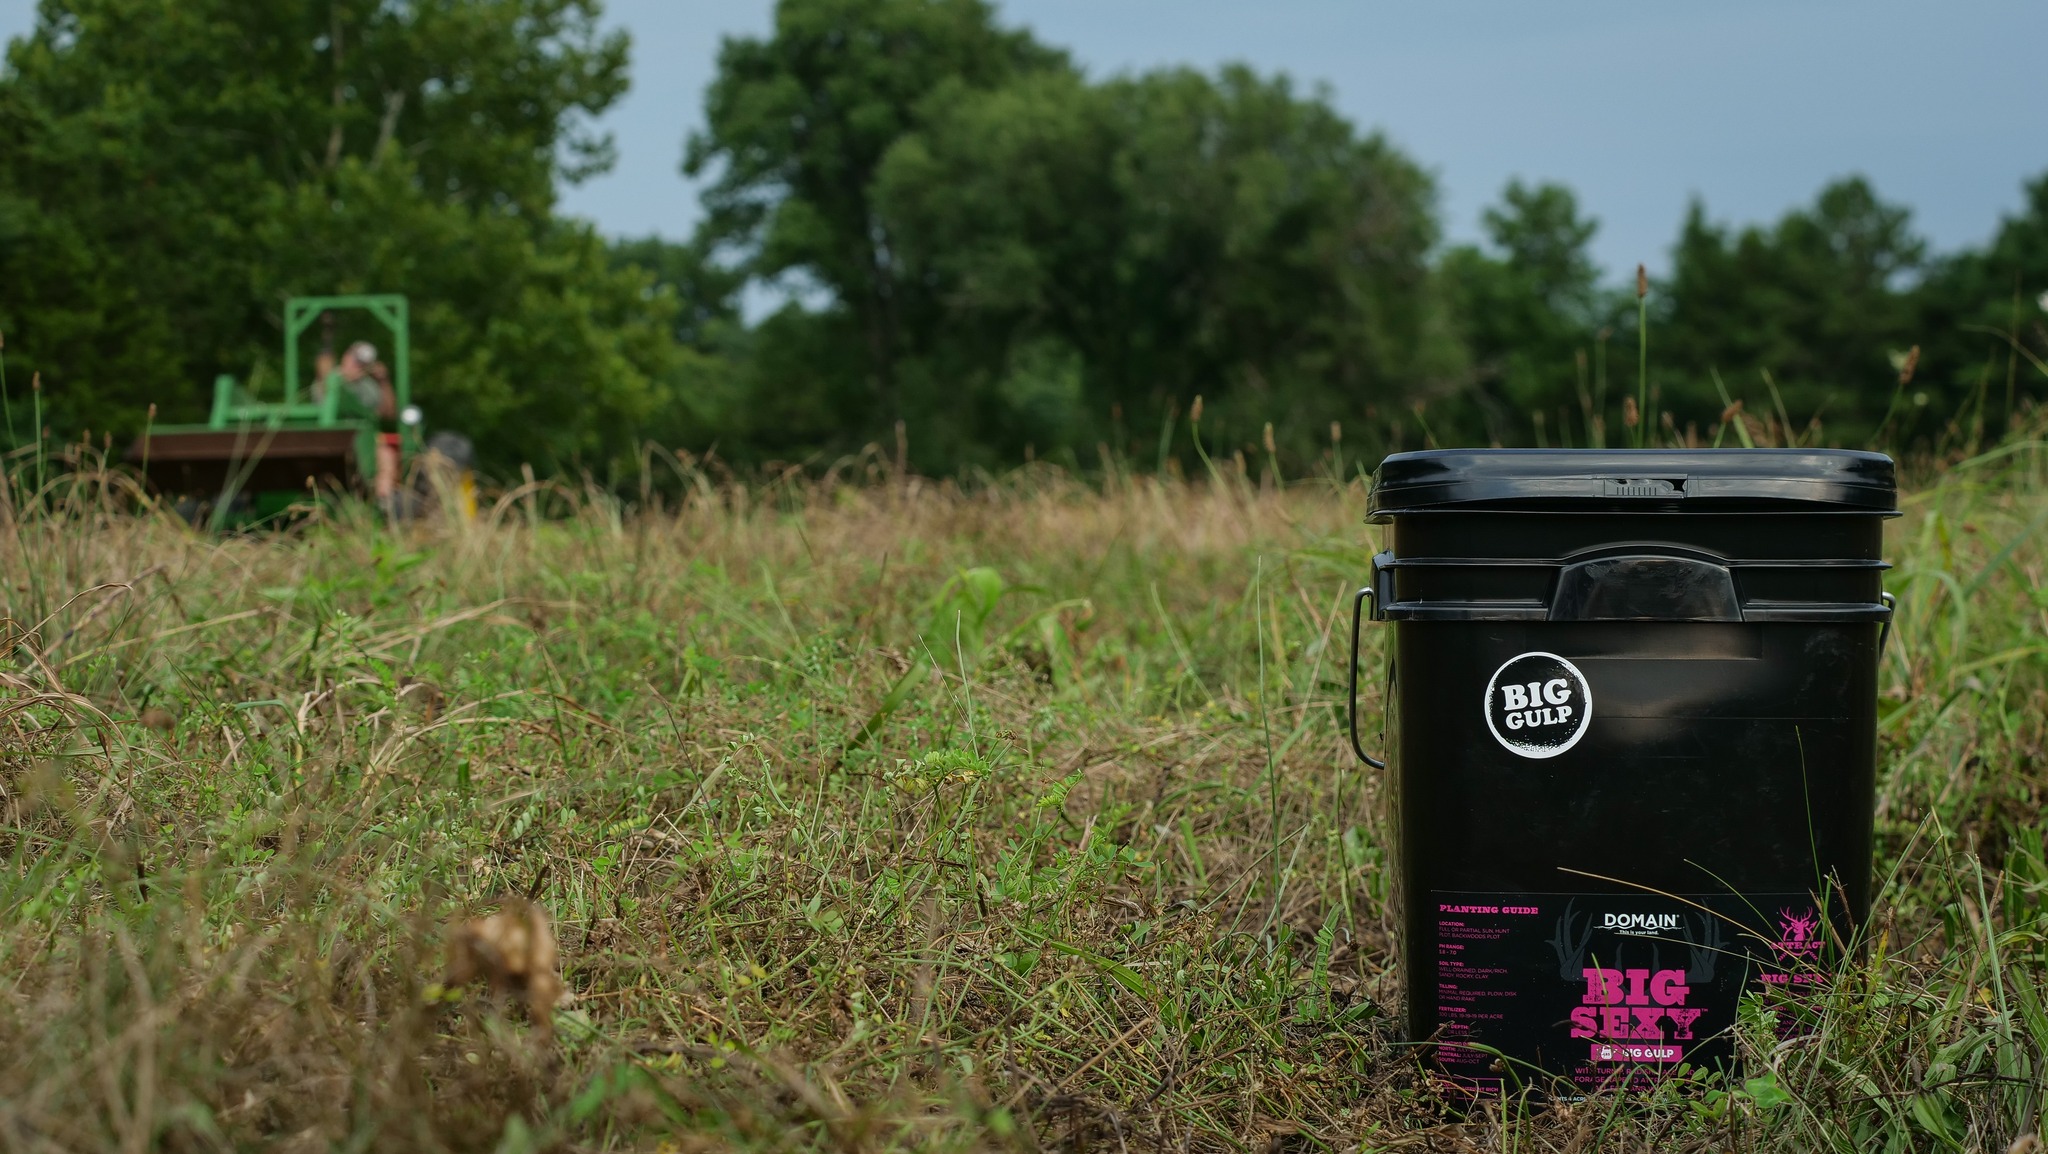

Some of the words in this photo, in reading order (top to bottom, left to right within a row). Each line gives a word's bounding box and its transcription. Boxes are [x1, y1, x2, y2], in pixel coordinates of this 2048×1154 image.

[1501, 678, 1572, 710] BIG
[1505, 705, 1573, 730] GULP
[1439, 904, 1499, 914] PLANTING
[1501, 906, 1539, 915] GUIDE
[1604, 913, 1676, 927] DOMAIN
[1769, 941, 1826, 950] ATTRACT
[1760, 973, 1789, 984] BIG
[1793, 973, 1832, 984] SEX
[1582, 968, 1690, 1006] BIG
[1622, 1048, 1642, 1058] BIG
[1644, 1049, 1674, 1058] GULP
[1596, 1067, 1625, 1075] TURNP,
